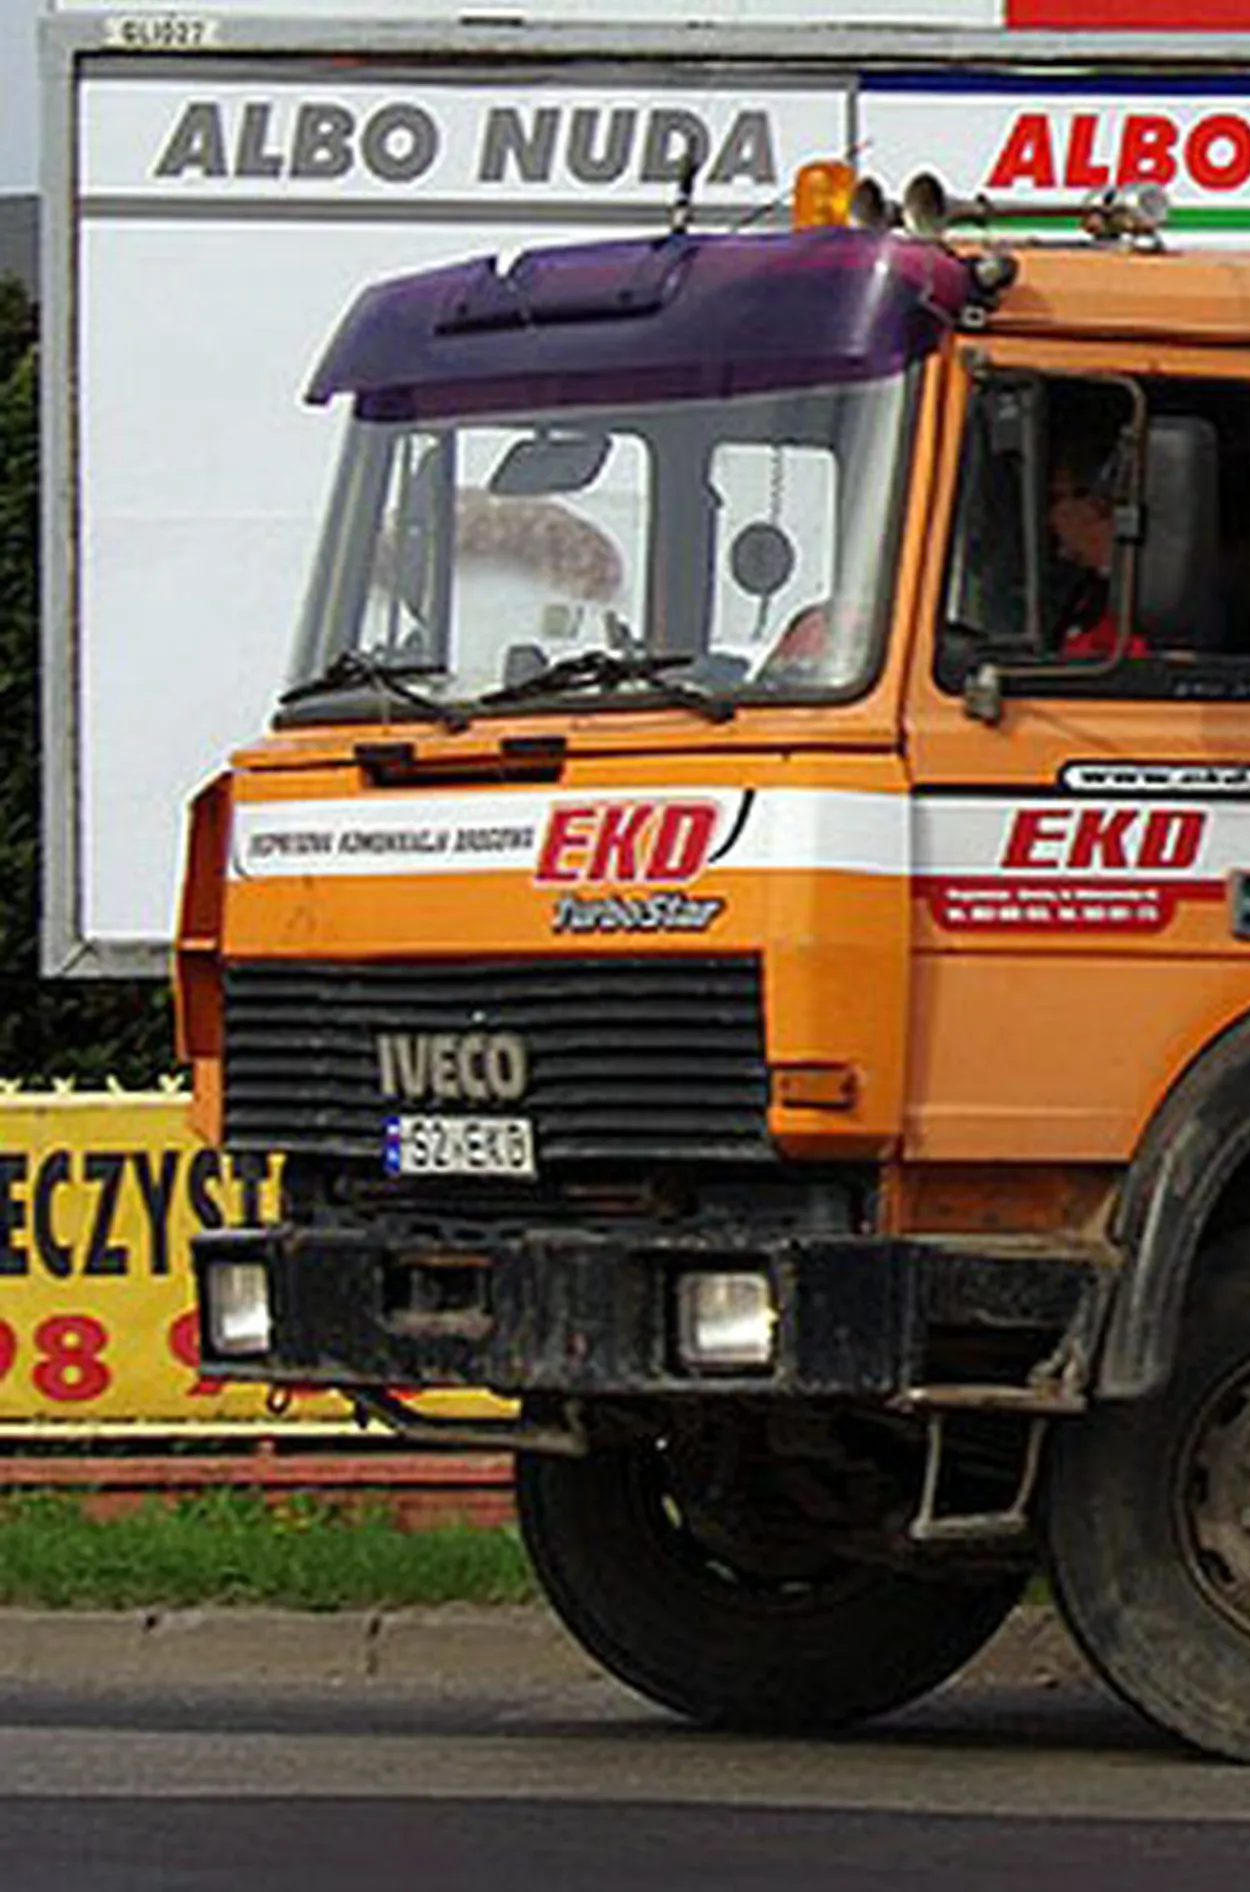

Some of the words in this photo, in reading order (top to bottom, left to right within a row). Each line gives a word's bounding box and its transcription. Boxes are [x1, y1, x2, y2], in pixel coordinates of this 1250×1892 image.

[156, 103, 440, 183] ALBO
[478, 110, 778, 186] NUDA
[535, 801, 719, 882] EKD
[1000, 809, 1207, 870] EKD
[376, 1033, 527, 1104] IVECO
